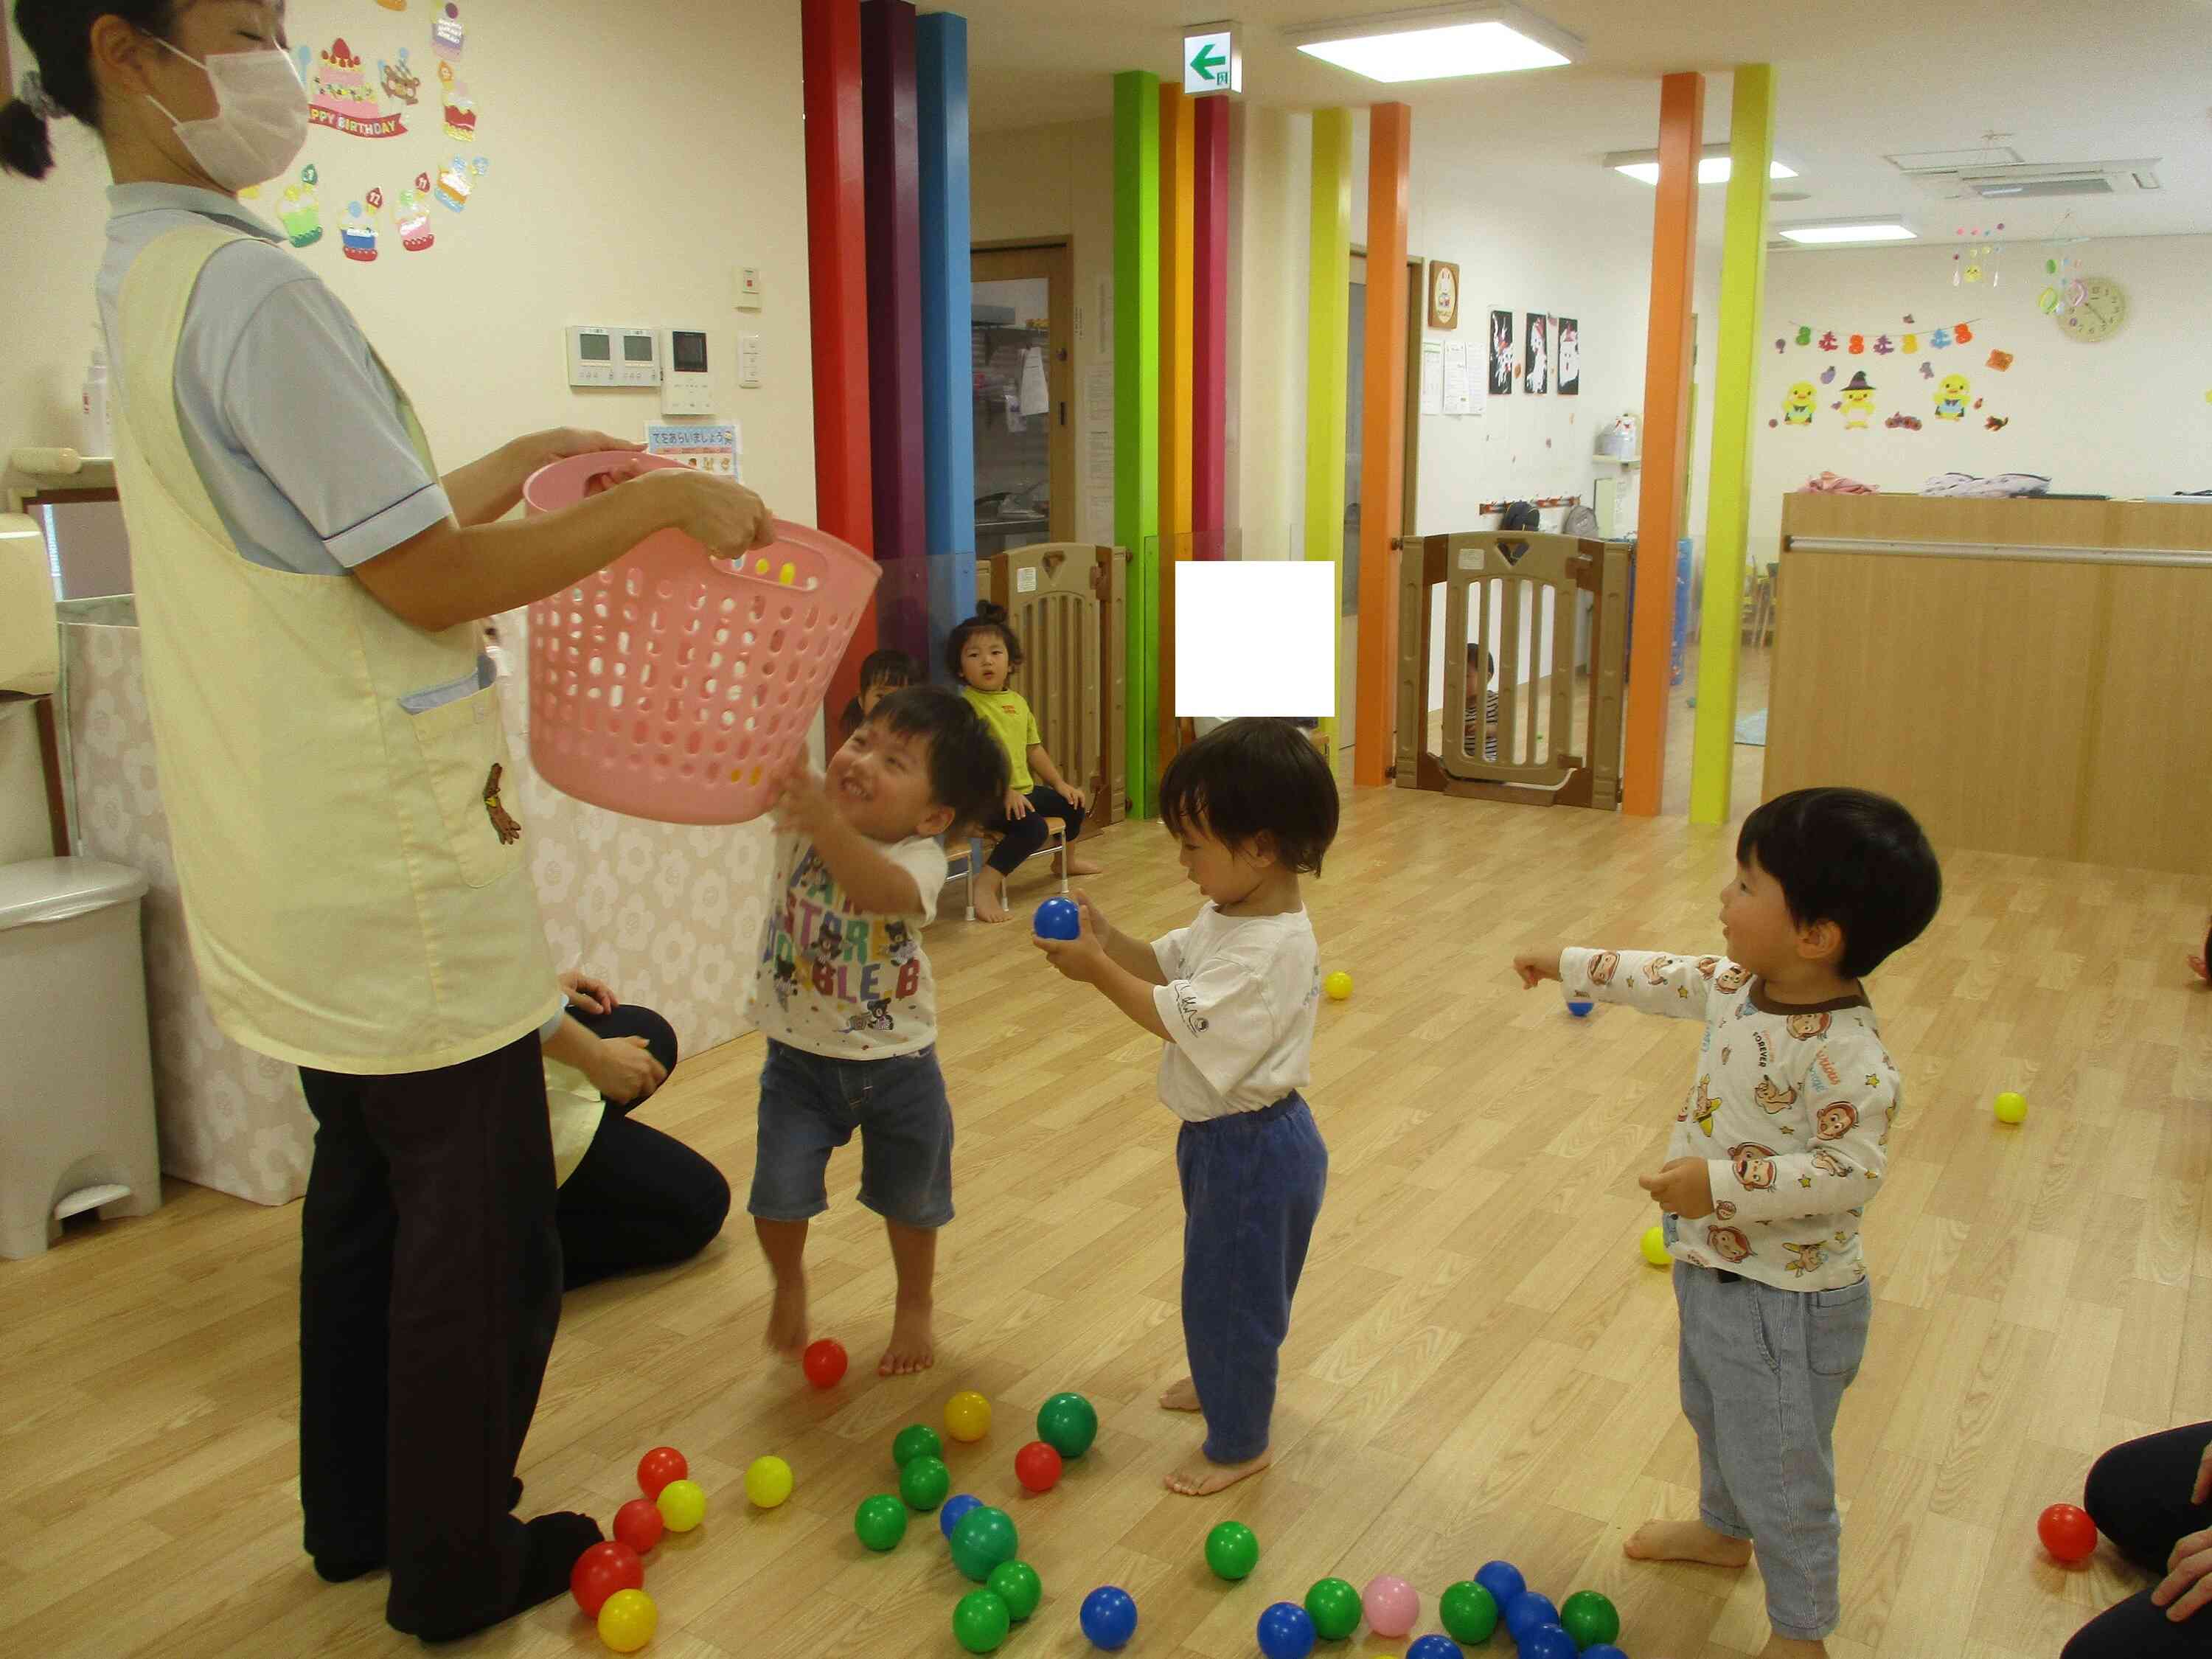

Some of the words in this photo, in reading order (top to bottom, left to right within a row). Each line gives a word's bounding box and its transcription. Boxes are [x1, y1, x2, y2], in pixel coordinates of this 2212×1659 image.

[310, 108, 335, 125] PPY
[337, 116, 396, 135] BIRTHDAY
[653, 432, 723, 444] てをあらいましょう
